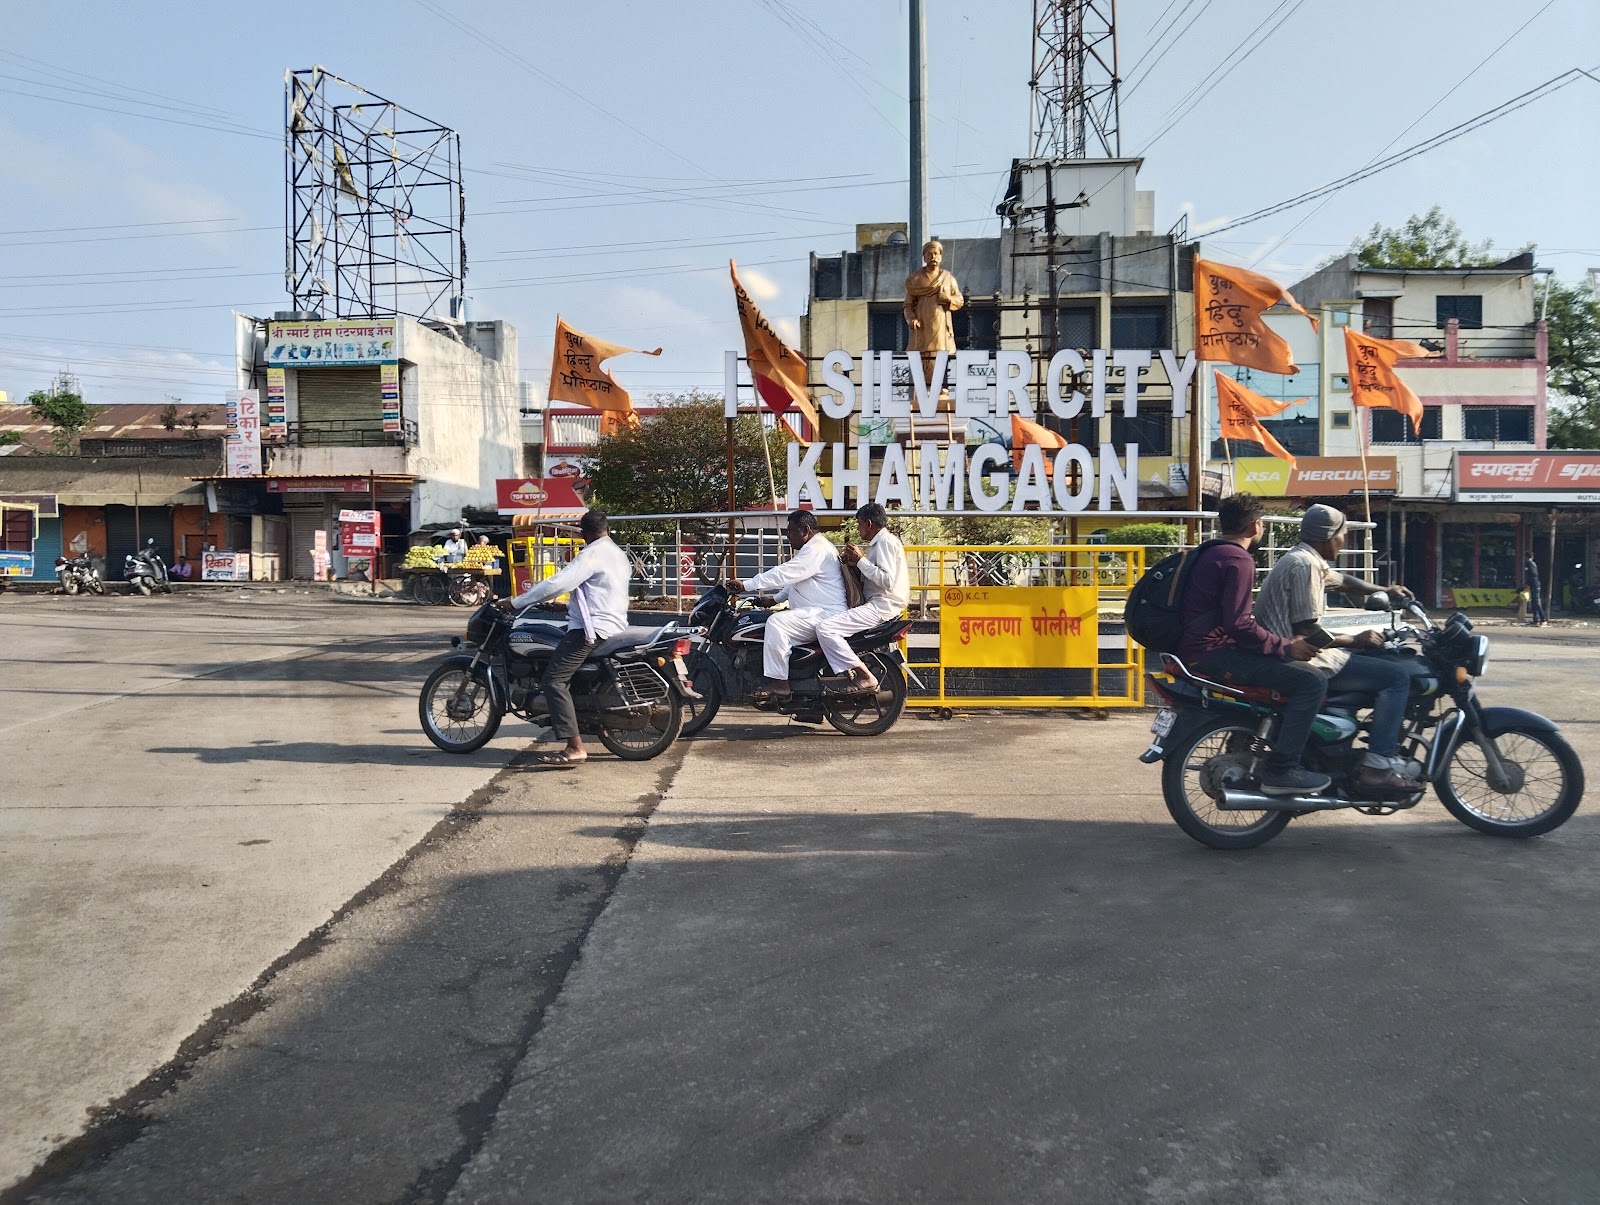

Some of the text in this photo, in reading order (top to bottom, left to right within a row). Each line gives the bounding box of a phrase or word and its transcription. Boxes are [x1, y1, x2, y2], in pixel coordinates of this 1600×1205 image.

[1209, 274, 1236, 295] युवा
[286, 325, 310, 338] स्मार्ट
[313, 325, 332, 339] होम
[725, 350, 738, 418] I
[786, 442, 1139, 511] KHAMGAON
[1245, 471, 1281, 482] BSA
[1297, 470, 1392, 481] HERCULES
[946, 592, 961, 601] 430
[959, 607, 1082, 645] बुलढाणा पोलीस
